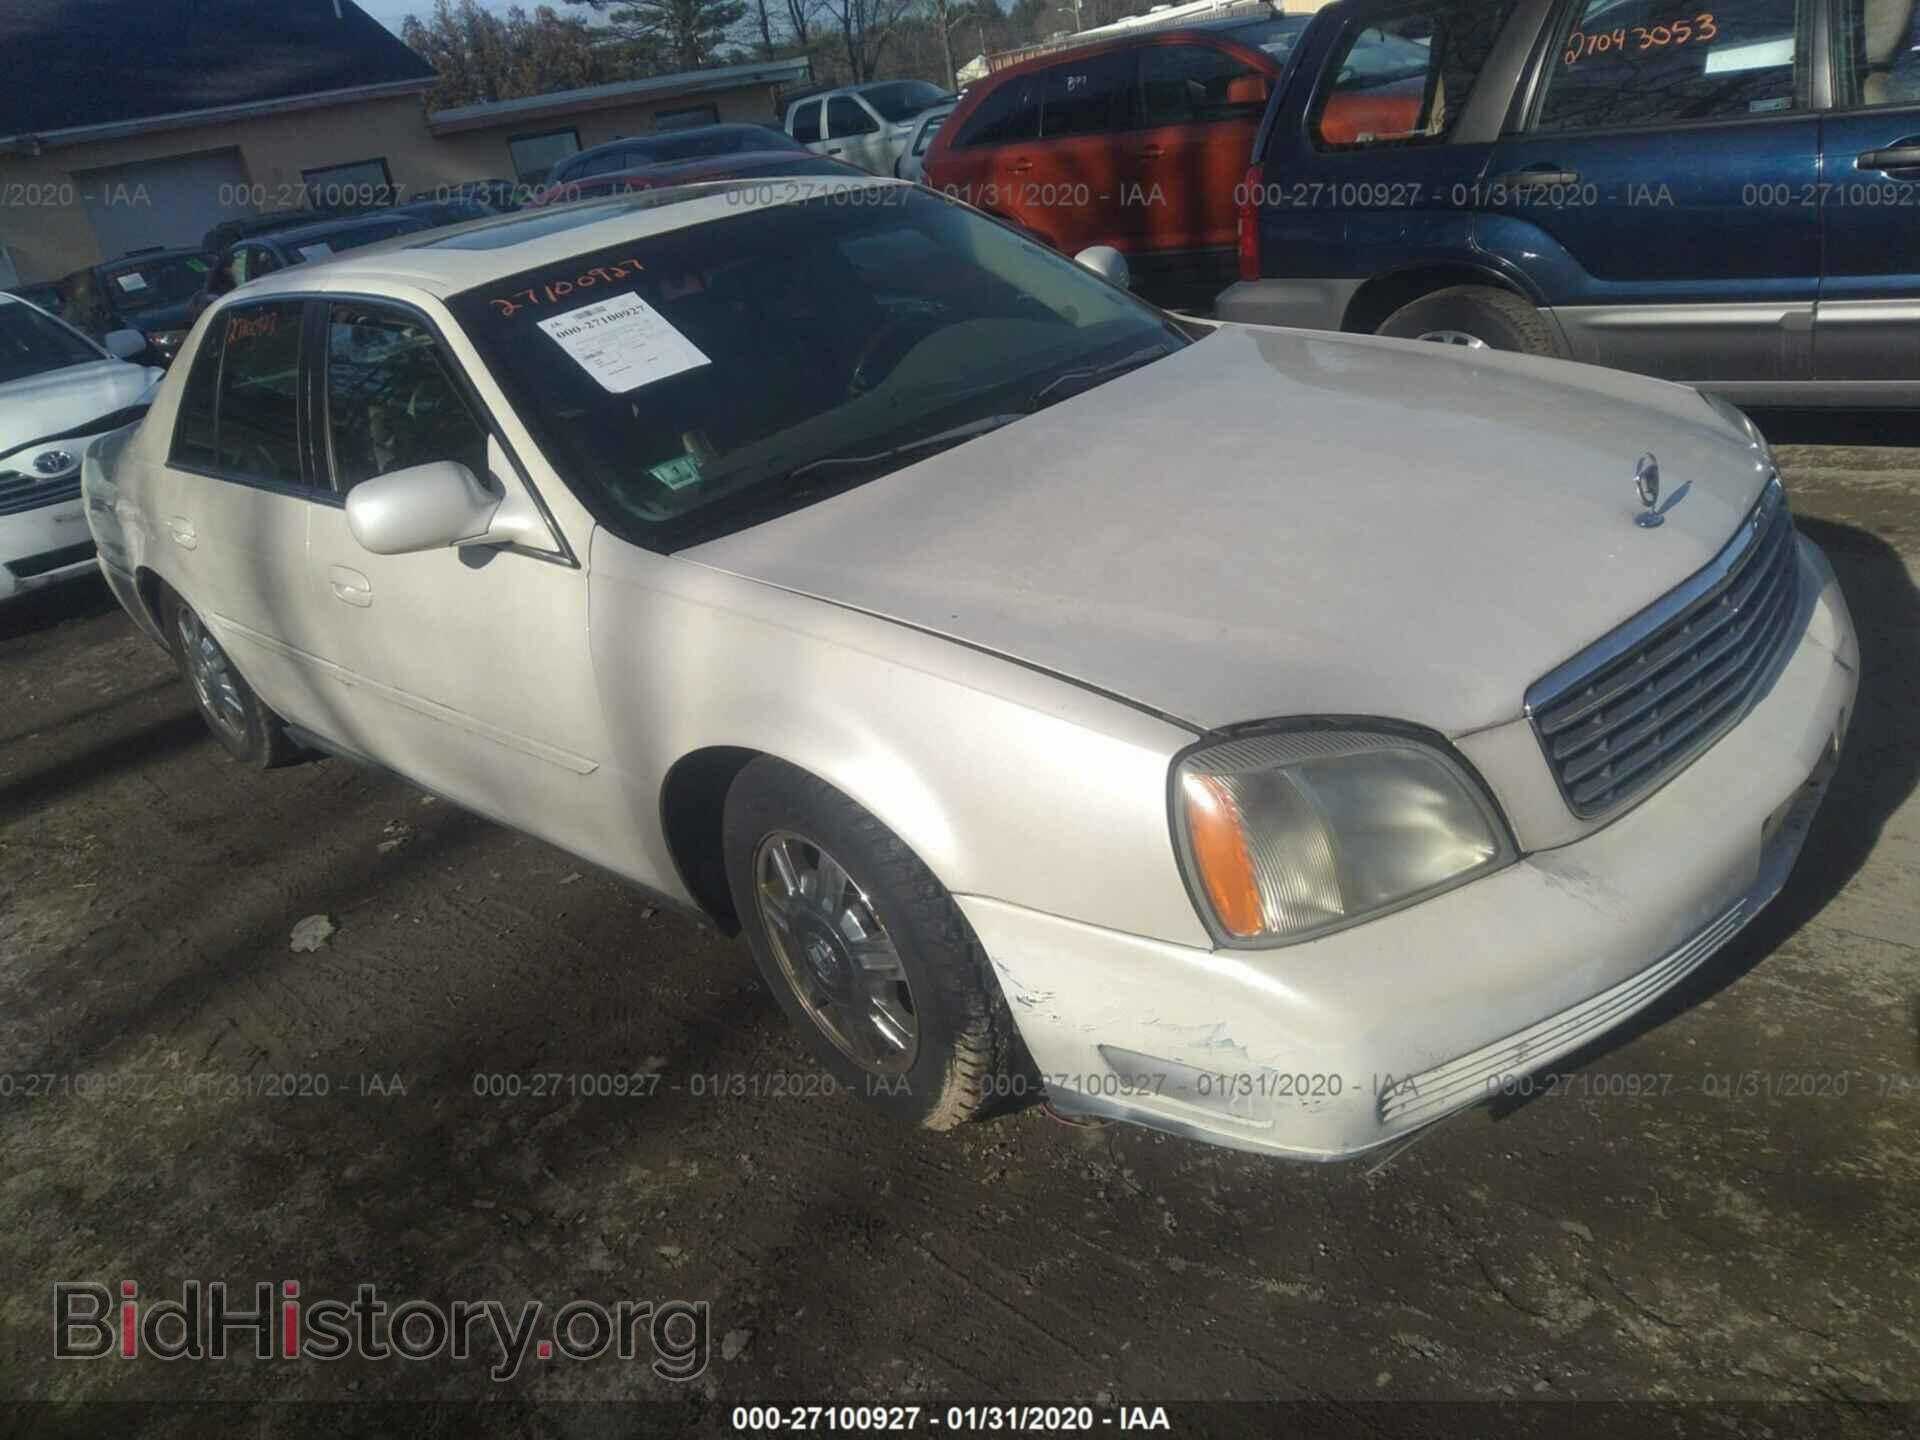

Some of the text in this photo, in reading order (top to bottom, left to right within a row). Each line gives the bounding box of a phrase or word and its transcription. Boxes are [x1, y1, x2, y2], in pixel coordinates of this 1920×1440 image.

[1564, 13, 1718, 65] 27043053
[488, 258, 646, 317] 27100927
[555, 304, 646, 340] 000-27100927
